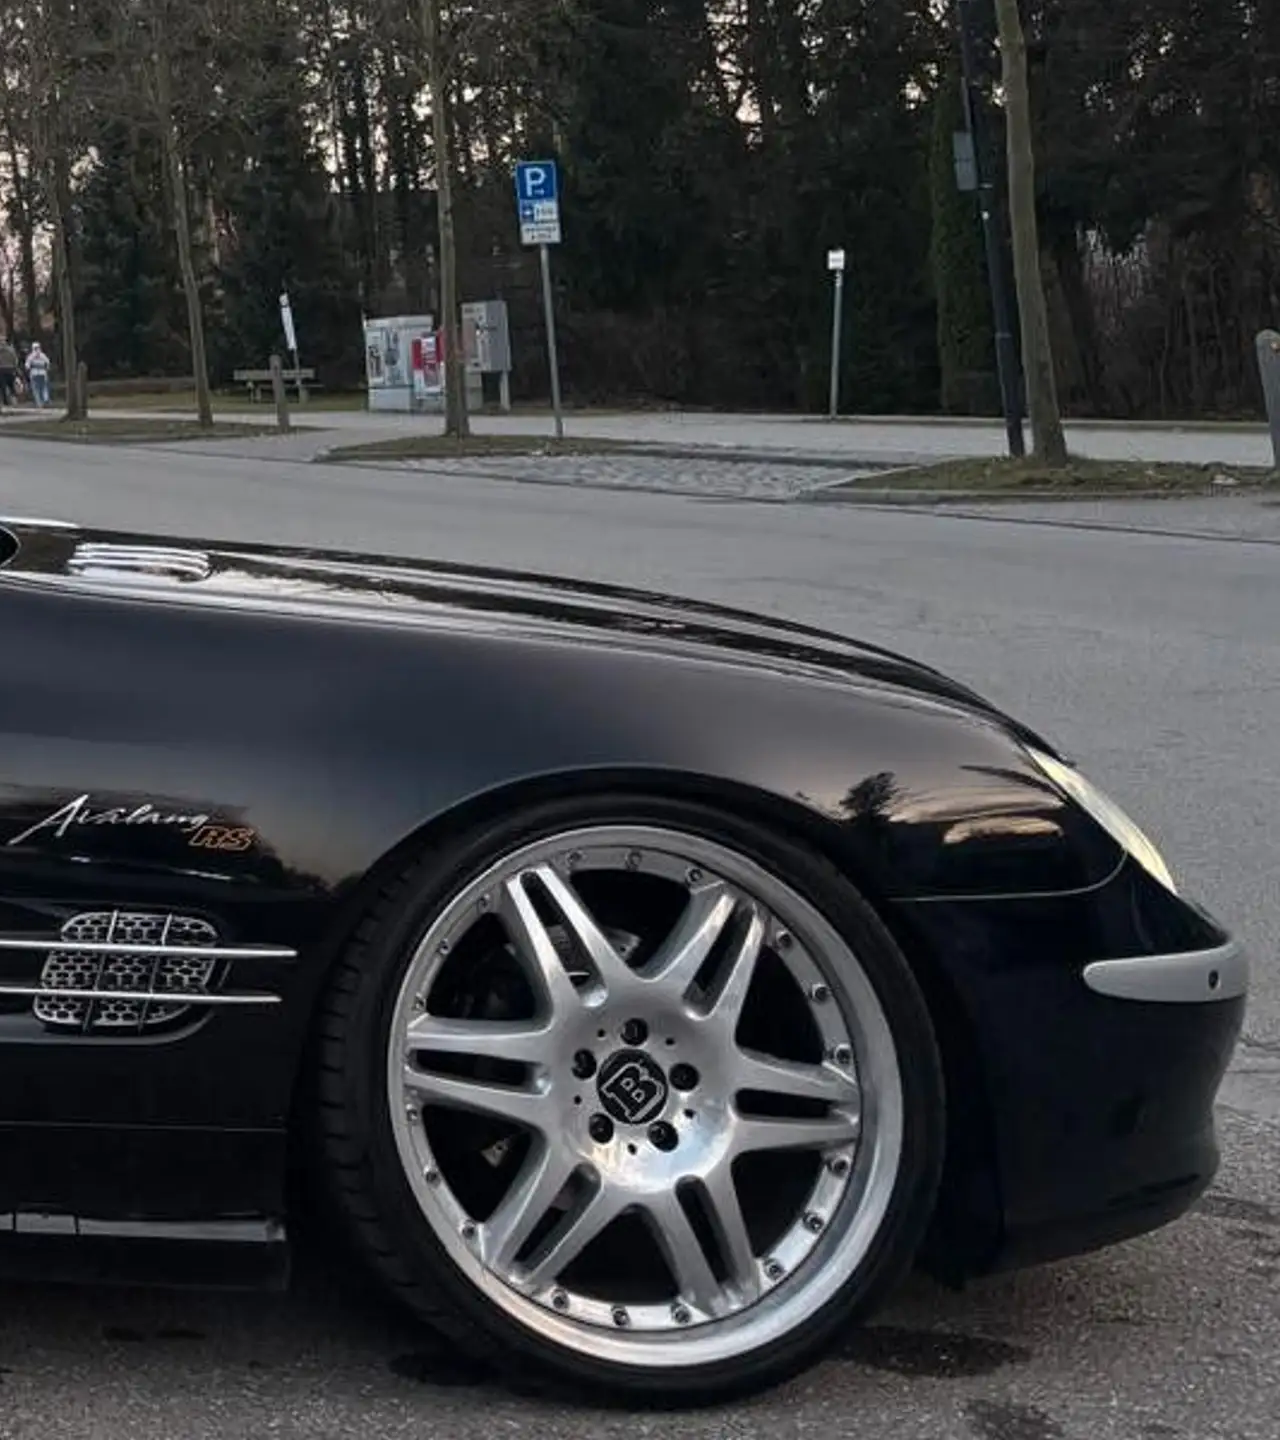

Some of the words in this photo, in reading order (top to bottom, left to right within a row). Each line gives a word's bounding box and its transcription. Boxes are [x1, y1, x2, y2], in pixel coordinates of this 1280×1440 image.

[524, 167, 547, 197] P
[188, 825, 254, 852] RS
[599, 1061, 666, 1123] B
